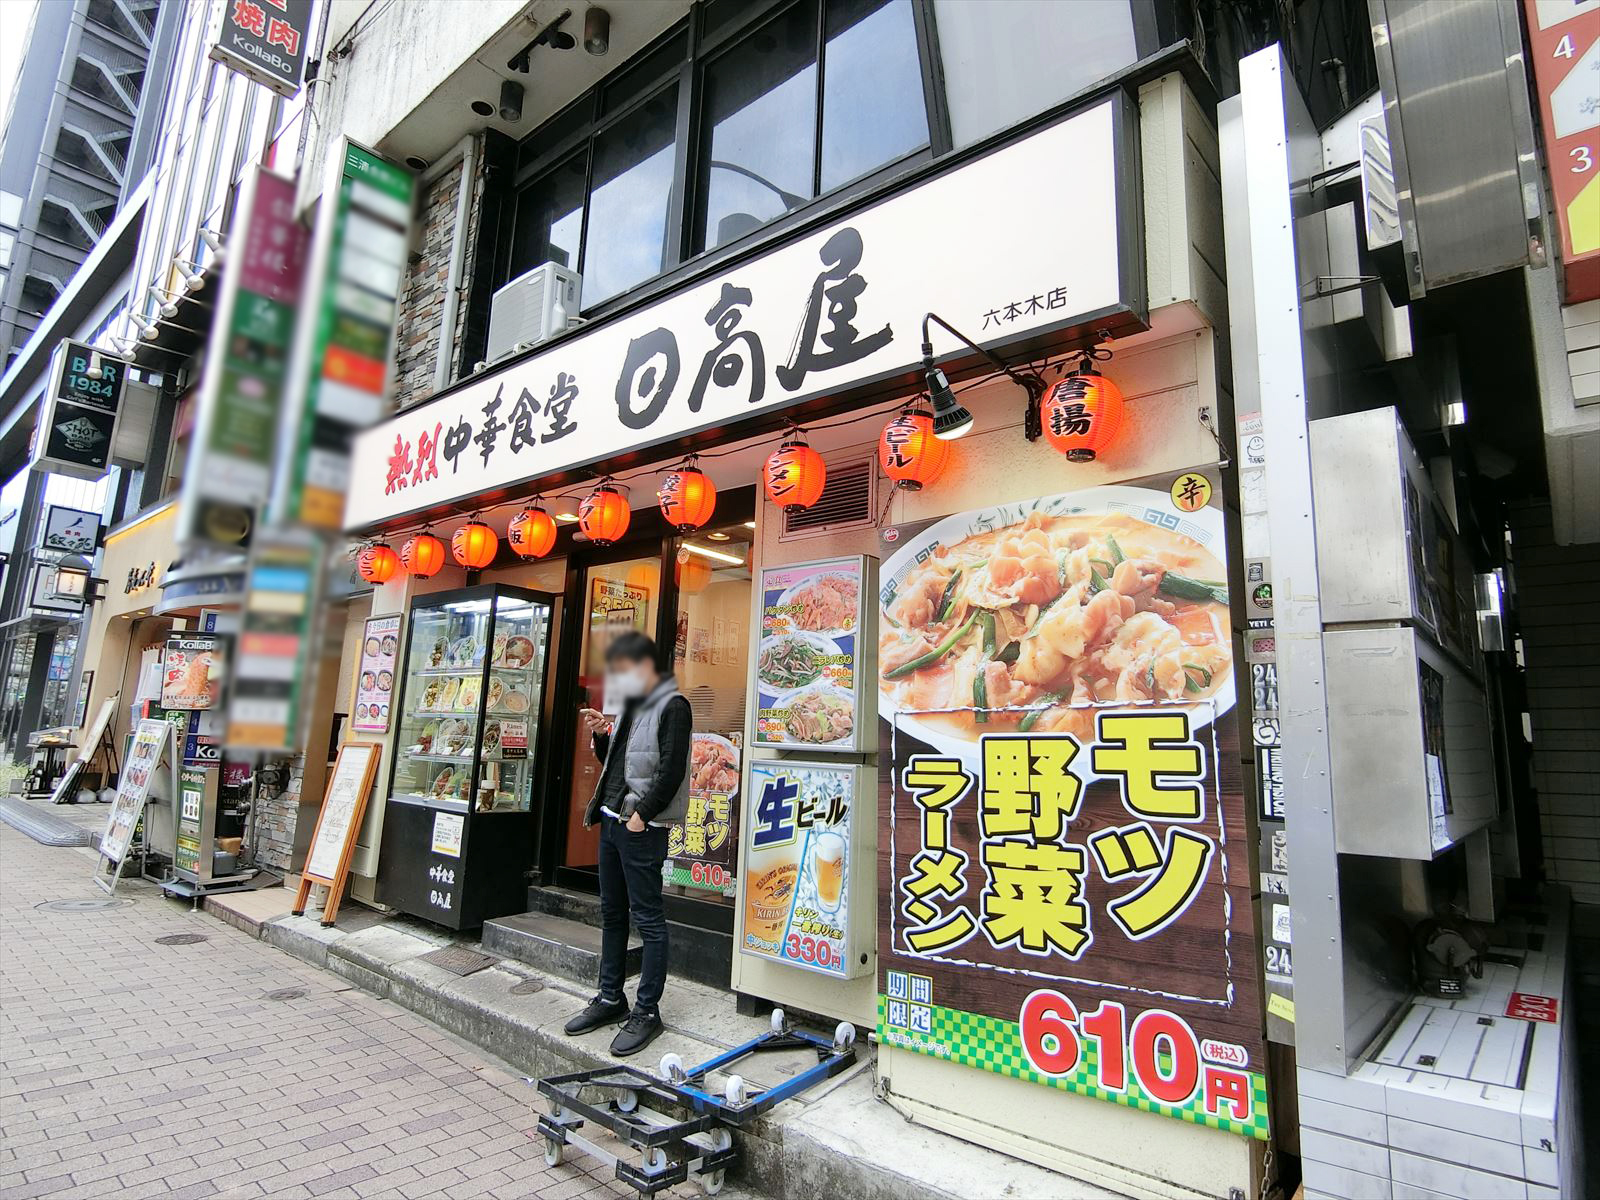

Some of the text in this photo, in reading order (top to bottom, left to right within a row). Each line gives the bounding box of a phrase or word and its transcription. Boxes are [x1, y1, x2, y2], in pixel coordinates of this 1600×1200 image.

[231, 0, 300, 56] 焼肉
[233, 33, 292, 73] KollaBo
[1552, 34, 1575, 59] 4
[1569, 146, 1593, 173] 3
[982, 286, 1067, 330] 六本木店
[615, 227, 893, 429] 日高屋
[71, 356, 117, 382] BR
[68, 374, 113, 398] 1984
[1048, 377, 1095, 436] 唐揚
[1176, 476, 1206, 509] 辛
[207, 621, 214, 630] 8
[180, 641, 214, 650] KollaB
[1253, 664, 1277, 687] 24
[1254, 688, 1278, 711] 24
[187, 743, 195, 751] 3
[707, 792, 731, 850] モツ
[753, 775, 848, 847] 生ビール
[686, 796, 708, 855] 野菜
[1090, 712, 1212, 938] モツ
[905, 758, 976, 953] ラーメン
[981, 735, 1090, 956] 野菜
[429, 864, 455, 884] 中華食堂
[430, 890, 452, 909] 日高屋
[795, 906, 819, 919] キリン
[757, 908, 780, 919] KIRIN
[1266, 946, 1292, 974] 24
[1202, 1038, 1248, 1064] (税込)
